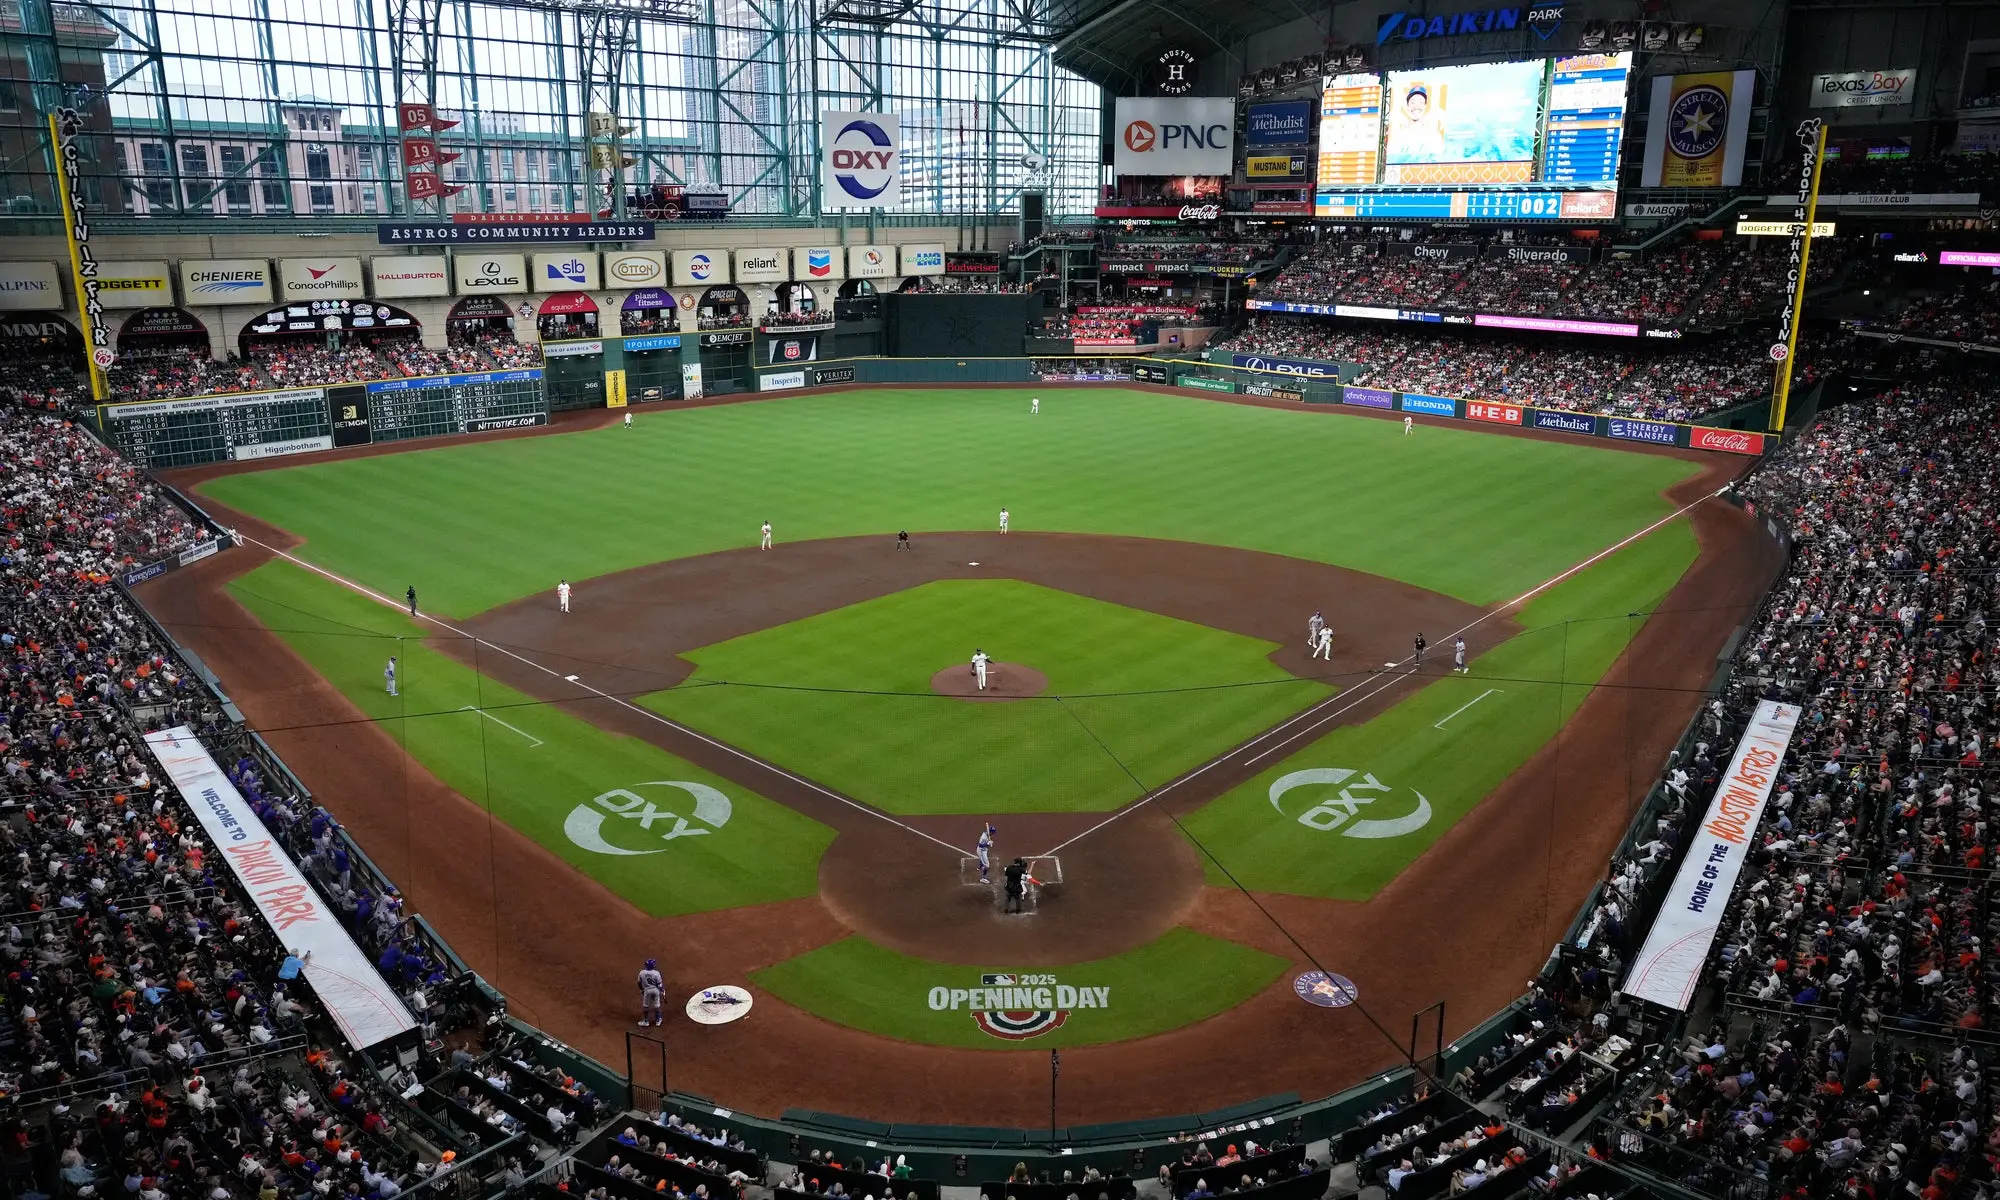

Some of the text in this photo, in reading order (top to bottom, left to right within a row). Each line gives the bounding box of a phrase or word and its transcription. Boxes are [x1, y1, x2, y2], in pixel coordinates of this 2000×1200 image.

[1404, 7, 1564, 39] DAIKIN PARK
[1159, 49, 1196, 63] HOUSTON
[1168, 64, 1185, 80] H
[1160, 81, 1193, 94] ASTROS
[1819, 72, 1909, 94] Texas Bay
[1675, 93, 1725, 114] ESTRELLA
[1846, 94, 1902, 104] CREDIT UNION
[407, 109, 427, 123] 05
[1251, 115, 1305, 131] Methodist
[594, 117, 610, 131] 17
[1160, 124, 1228, 150] PNC
[412, 145, 430, 158] 19
[1675, 138, 1717, 153] JALISCO
[596, 152, 612, 162] 22
[832, 149, 894, 170] OXY
[1253, 160, 1305, 172] MUSTANG CAT
[415, 178, 432, 190] 21
[1798, 152, 1815, 204] ROOT
[1795, 207, 1805, 220] 4
[392, 225, 645, 239] ASTROS COMMUNITY LEADERS
[64, 145, 108, 346] CHIKIN IZ FAIR
[917, 252, 942, 266] LNG
[1414, 245, 1568, 262] Chevy Silverado
[1894, 252, 1920, 262] reliant
[562, 259, 585, 275] slb
[691, 263, 711, 271] OXY
[743, 256, 777, 269] reliant
[947, 261, 999, 273] Budweiser
[1109, 263, 1189, 273] impact impact
[190, 271, 263, 282] CHENIERE
[377, 271, 444, 281] HALLIBURTON
[617, 263, 654, 277] COTTON
[287, 278, 359, 291] ConocoPhillips
[465, 276, 519, 286] LEXUS
[1127, 278, 1174, 287] Budweiser
[635, 292, 659, 301] planet
[710, 289, 738, 299] SPACE CITY
[638, 298, 663, 307] fitness
[1323, 305, 1330, 314] K
[1778, 269, 1798, 341] CHIKIN
[0, 322, 67, 337] MAVEN
[1443, 315, 1466, 324] reliant
[1646, 329, 1672, 338] reliant
[626, 337, 678, 349] 1POINTFIVE
[716, 333, 744, 342] EMCJET
[787, 348, 797, 356] 66
[823, 370, 853, 378] VERITEX
[1266, 363, 1324, 376] LEXUS
[771, 375, 803, 387] Insperity
[1246, 385, 1273, 397] SPACE CITY
[1346, 390, 1390, 405] xfinity mobile
[80, 408, 97, 418] 315
[1413, 400, 1453, 412] HONDA
[335, 419, 368, 429] BETMGM
[478, 416, 536, 431] NITTOTIRE.COM
[1538, 415, 1590, 431] Methodist
[1627, 421, 1666, 434] ENERGY
[222, 411, 233, 459] NATIONAL
[1627, 429, 1675, 443] TRANSFER
[1701, 431, 1750, 450] Coca-Cola
[265, 441, 321, 454] Higginbotham
[1731, 746, 1779, 790] ASTROS
[1297, 772, 1393, 831] OXY
[593, 788, 713, 841] OXY
[1704, 786, 1761, 844] HOUSTON
[200, 787, 321, 931] WELCOME TO DAIKIN PARK
[1708, 844, 1729, 864] THE
[1702, 862, 1719, 881] OF
[1687, 880, 1714, 913] HOME
[1020, 974, 1057, 985] 2025
[928, 984, 1111, 1011] OPENING DAY
